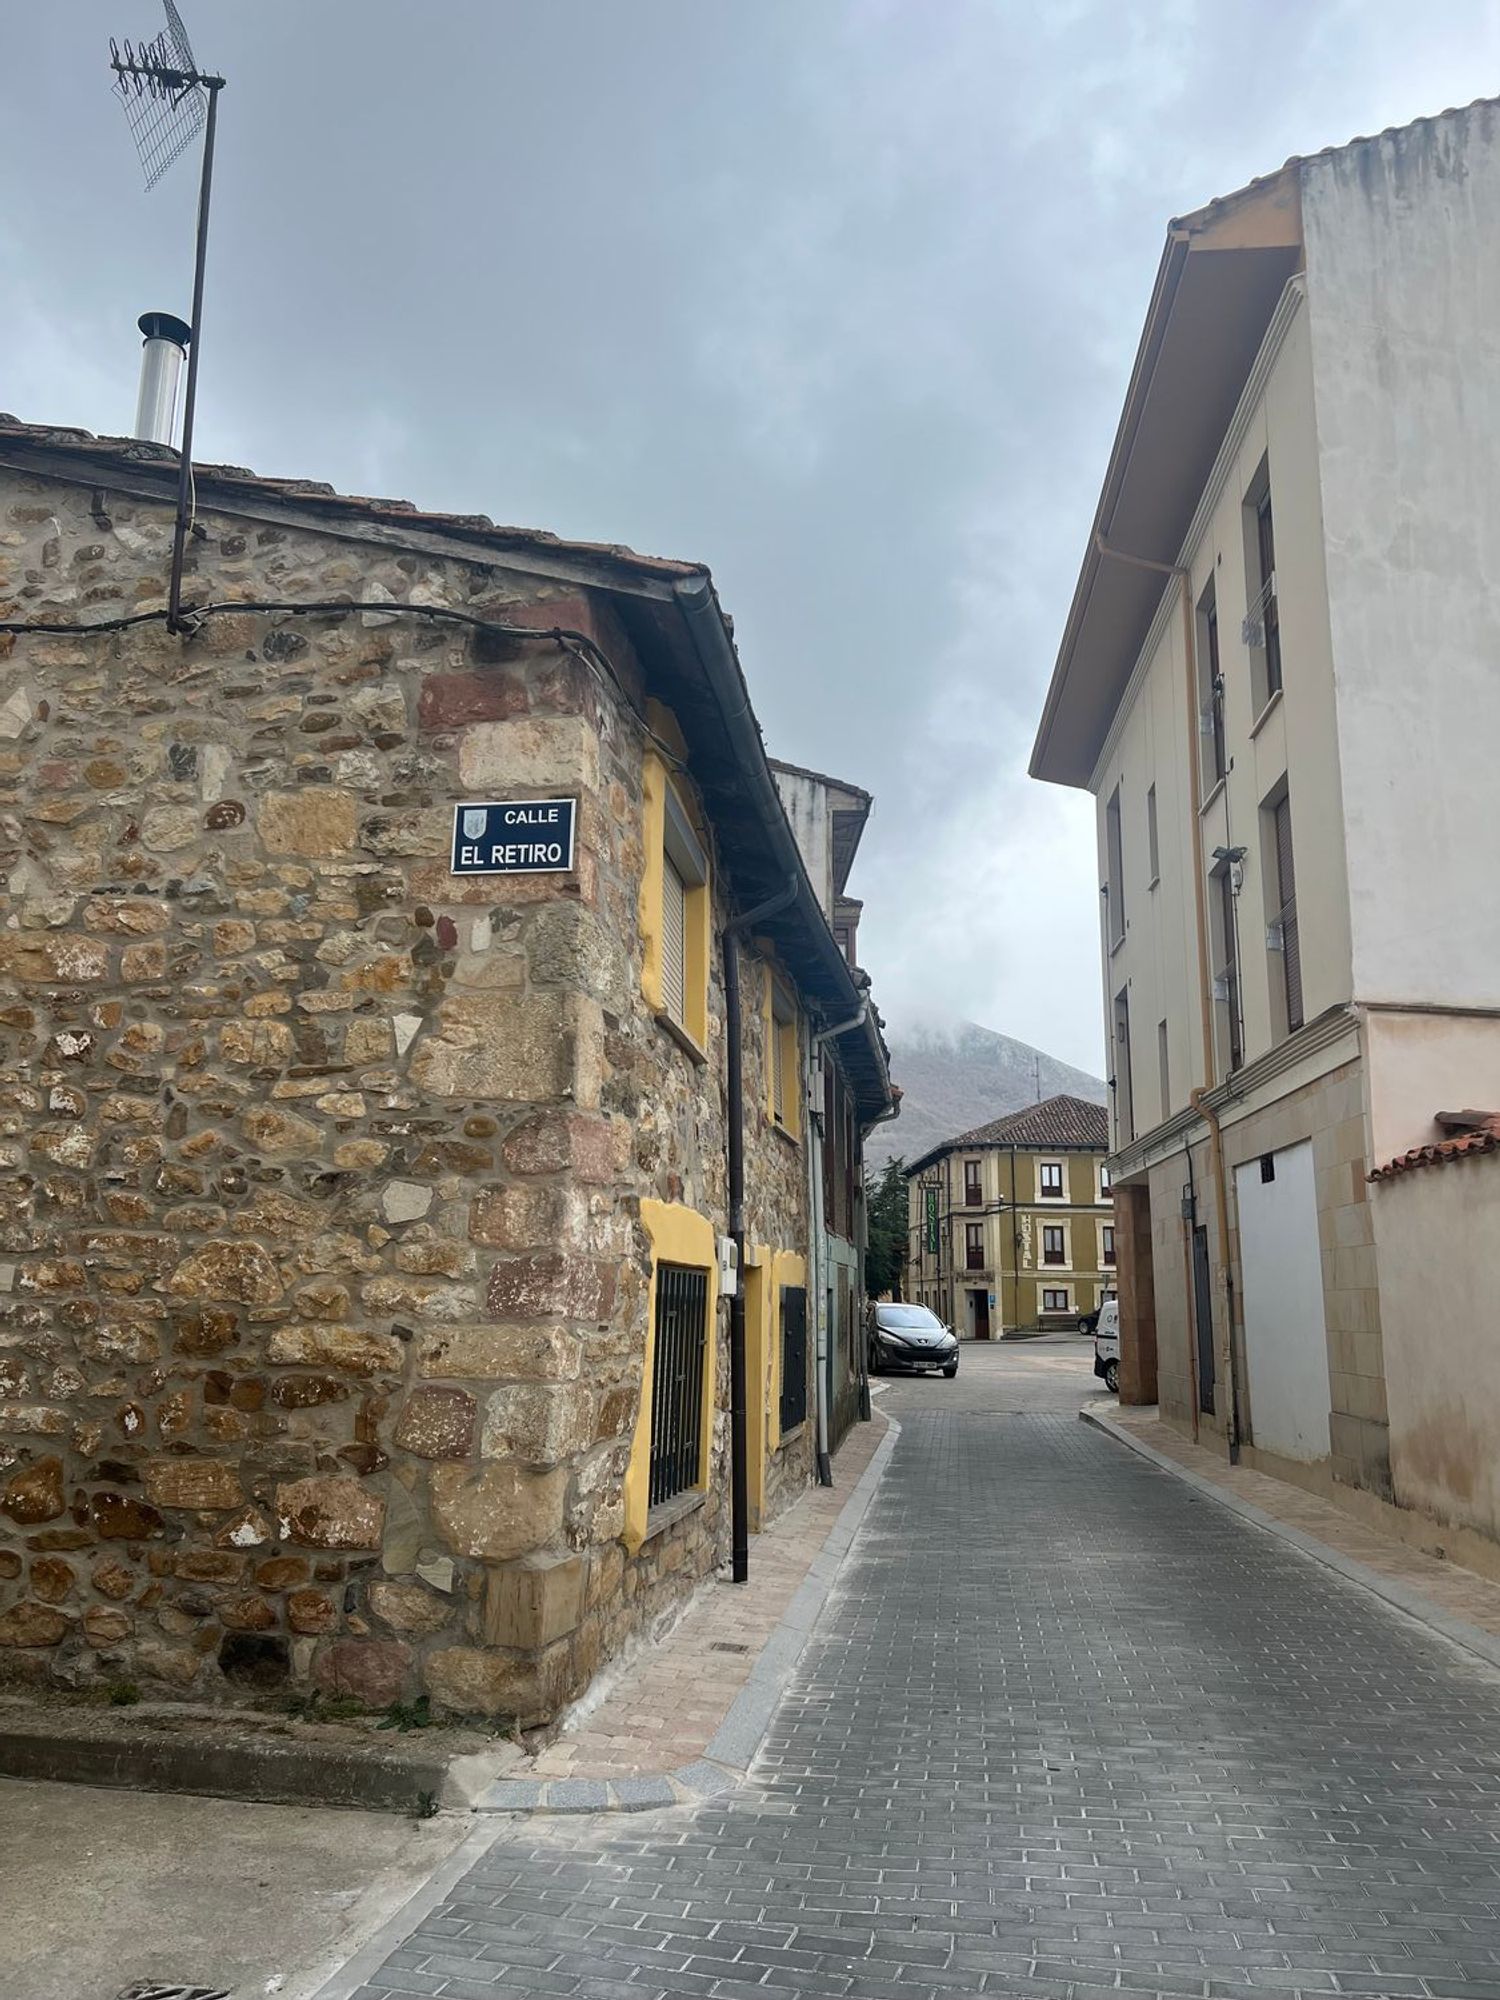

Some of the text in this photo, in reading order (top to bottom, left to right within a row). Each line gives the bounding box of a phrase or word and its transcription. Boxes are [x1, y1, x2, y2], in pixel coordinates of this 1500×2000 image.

[504, 808, 559, 825] CALLE
[460, 843, 562, 865] EL RETIRO
[927, 1192, 936, 1252] HOSTAL
[1021, 1214, 1032, 1269] HOSTAL
